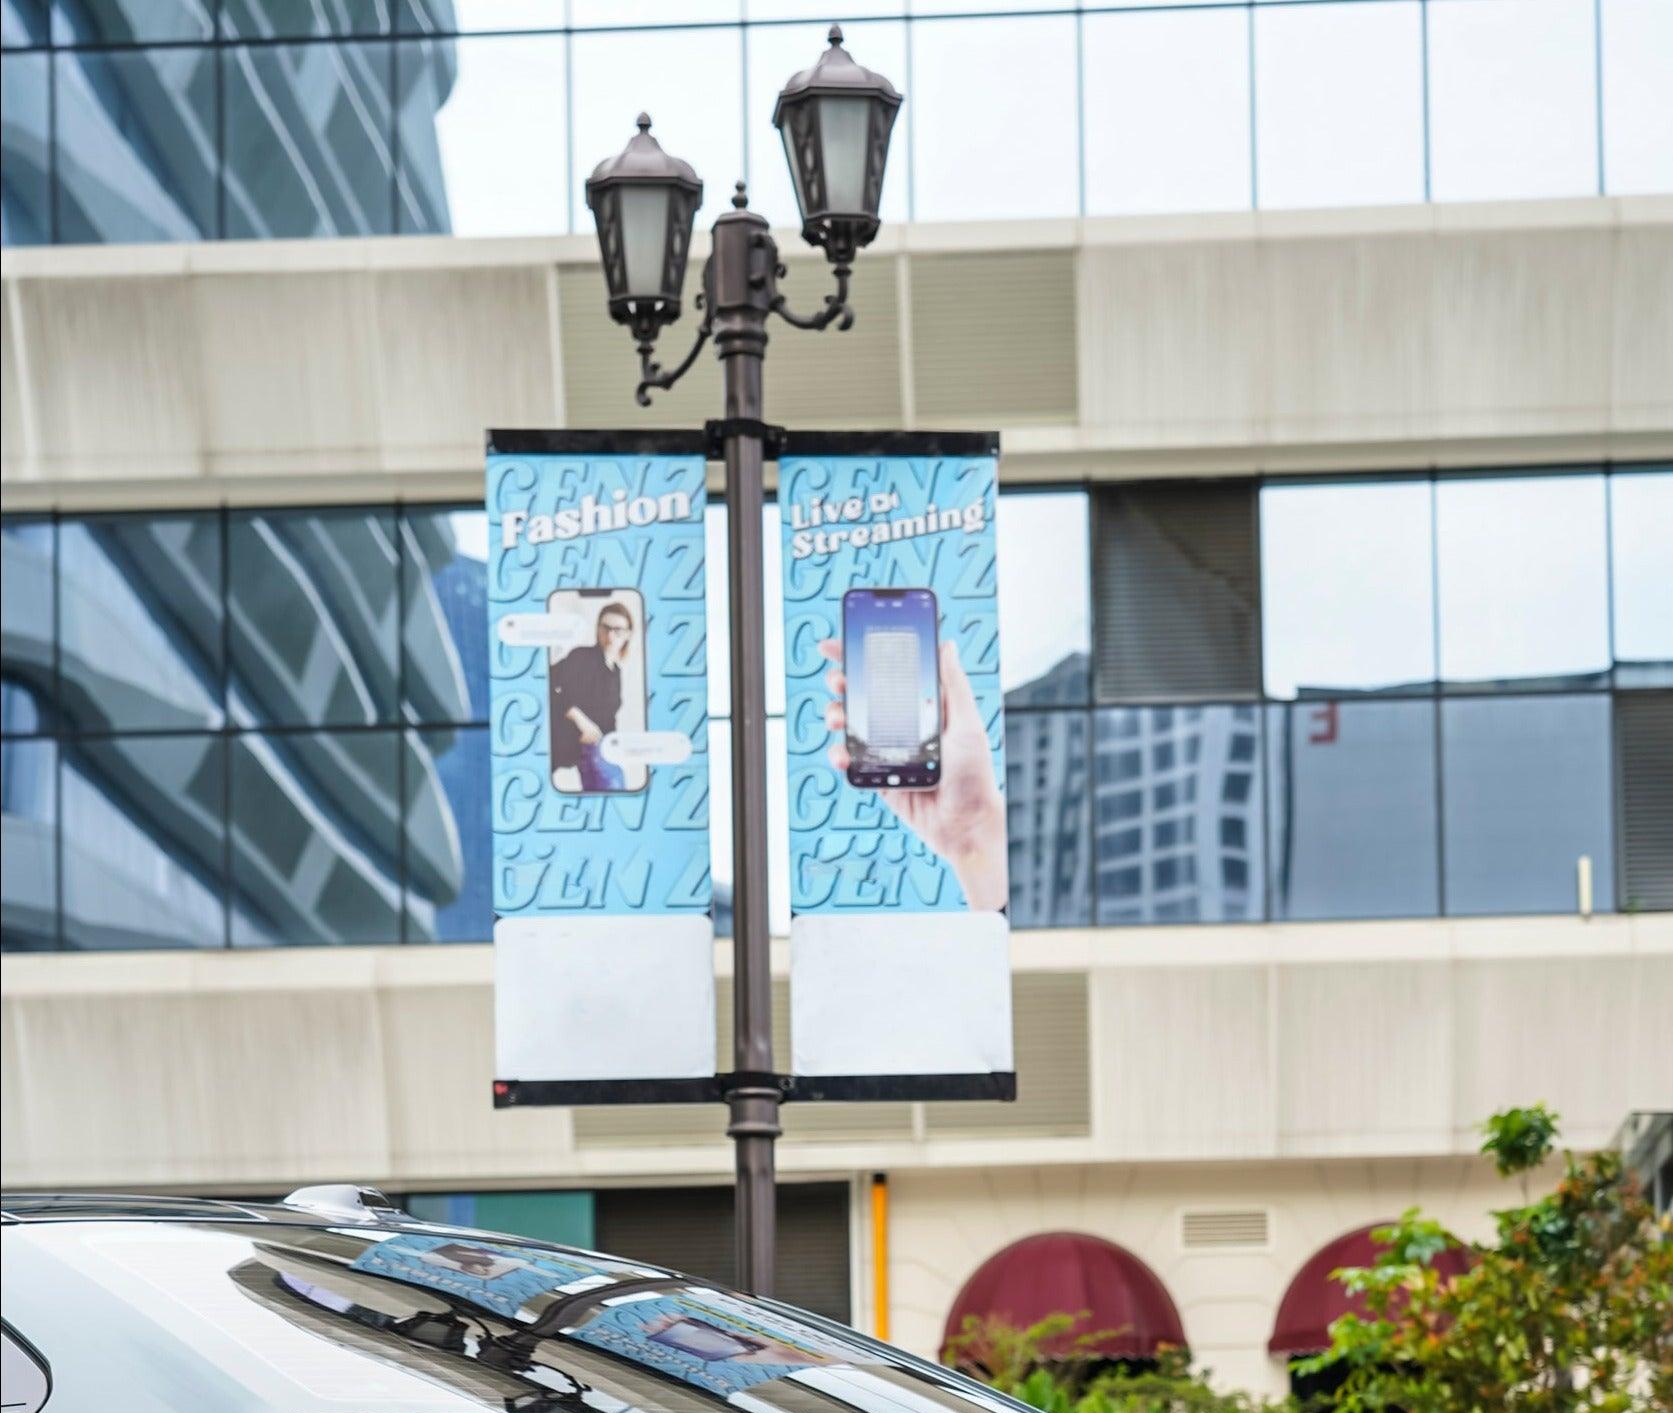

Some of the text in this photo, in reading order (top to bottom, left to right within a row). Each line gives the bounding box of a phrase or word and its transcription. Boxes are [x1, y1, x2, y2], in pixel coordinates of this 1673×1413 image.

[501, 489, 691, 549] Fashion
[792, 495, 865, 530] Live
[792, 498, 986, 559] Streaming
[789, 767, 900, 832] GE
